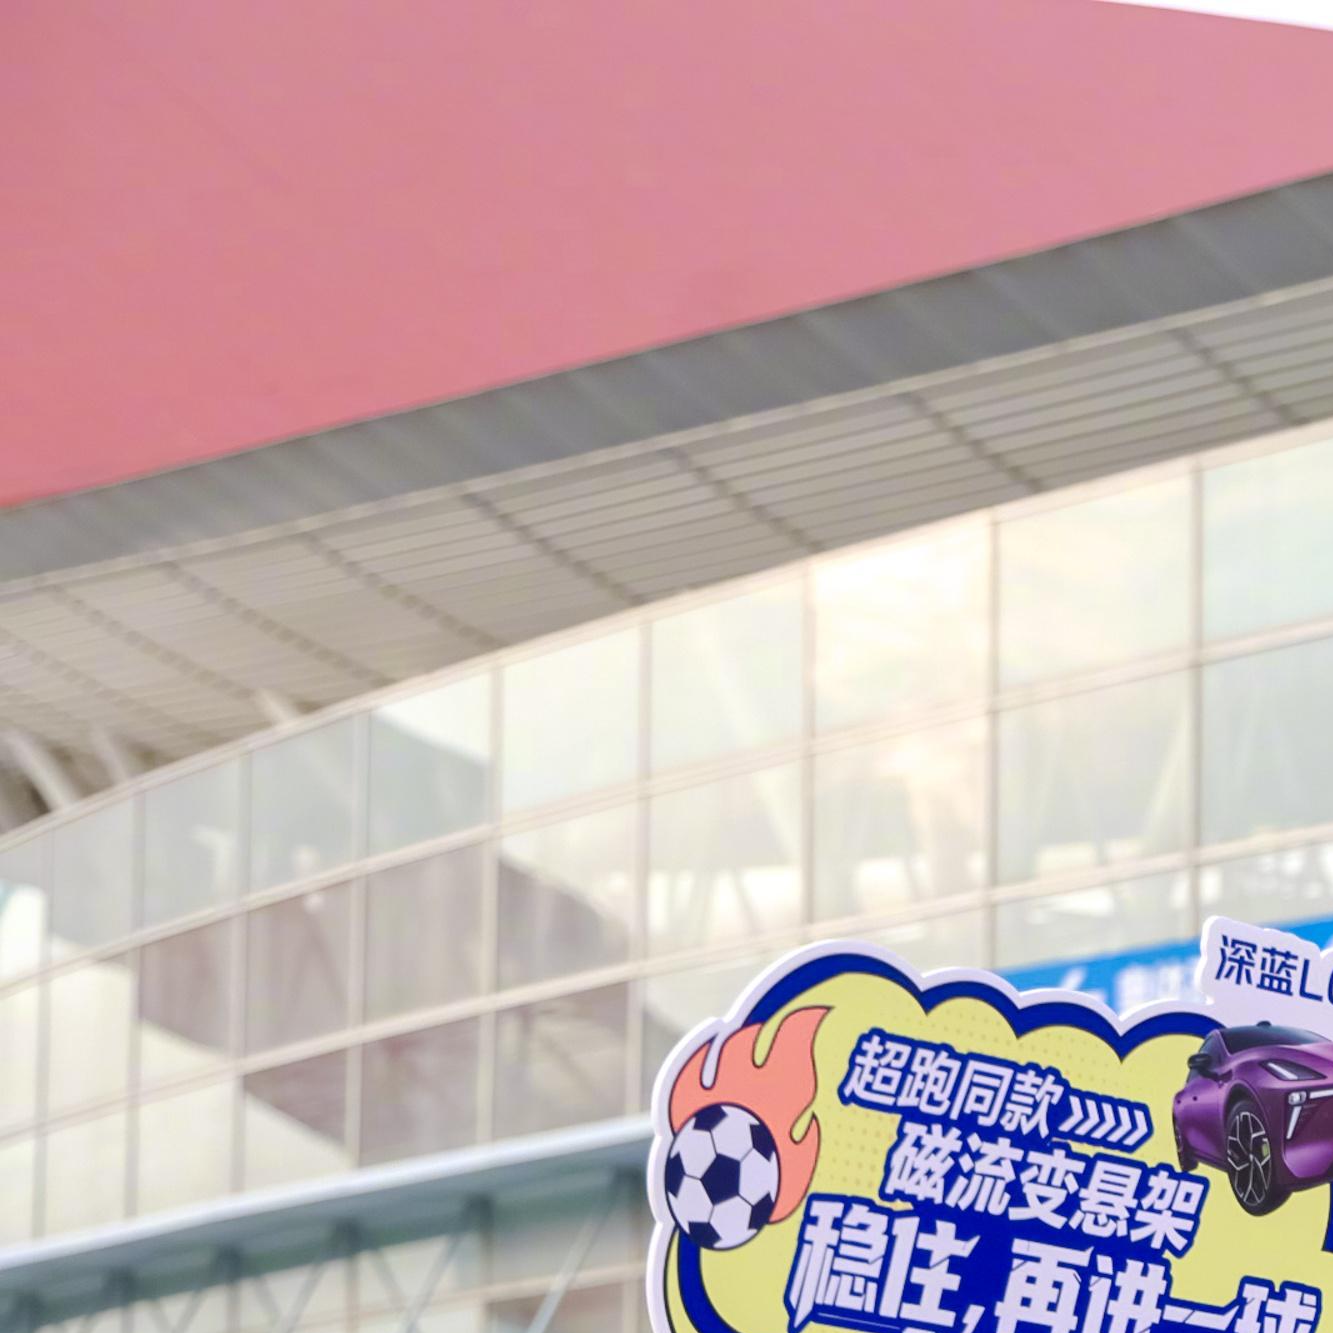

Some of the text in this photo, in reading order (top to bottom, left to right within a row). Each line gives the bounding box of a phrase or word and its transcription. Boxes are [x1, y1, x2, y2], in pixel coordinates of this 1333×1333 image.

[842, 1035, 1066, 1135] 超跑同款
[884, 1120, 1207, 1256] 磁流变悬架
